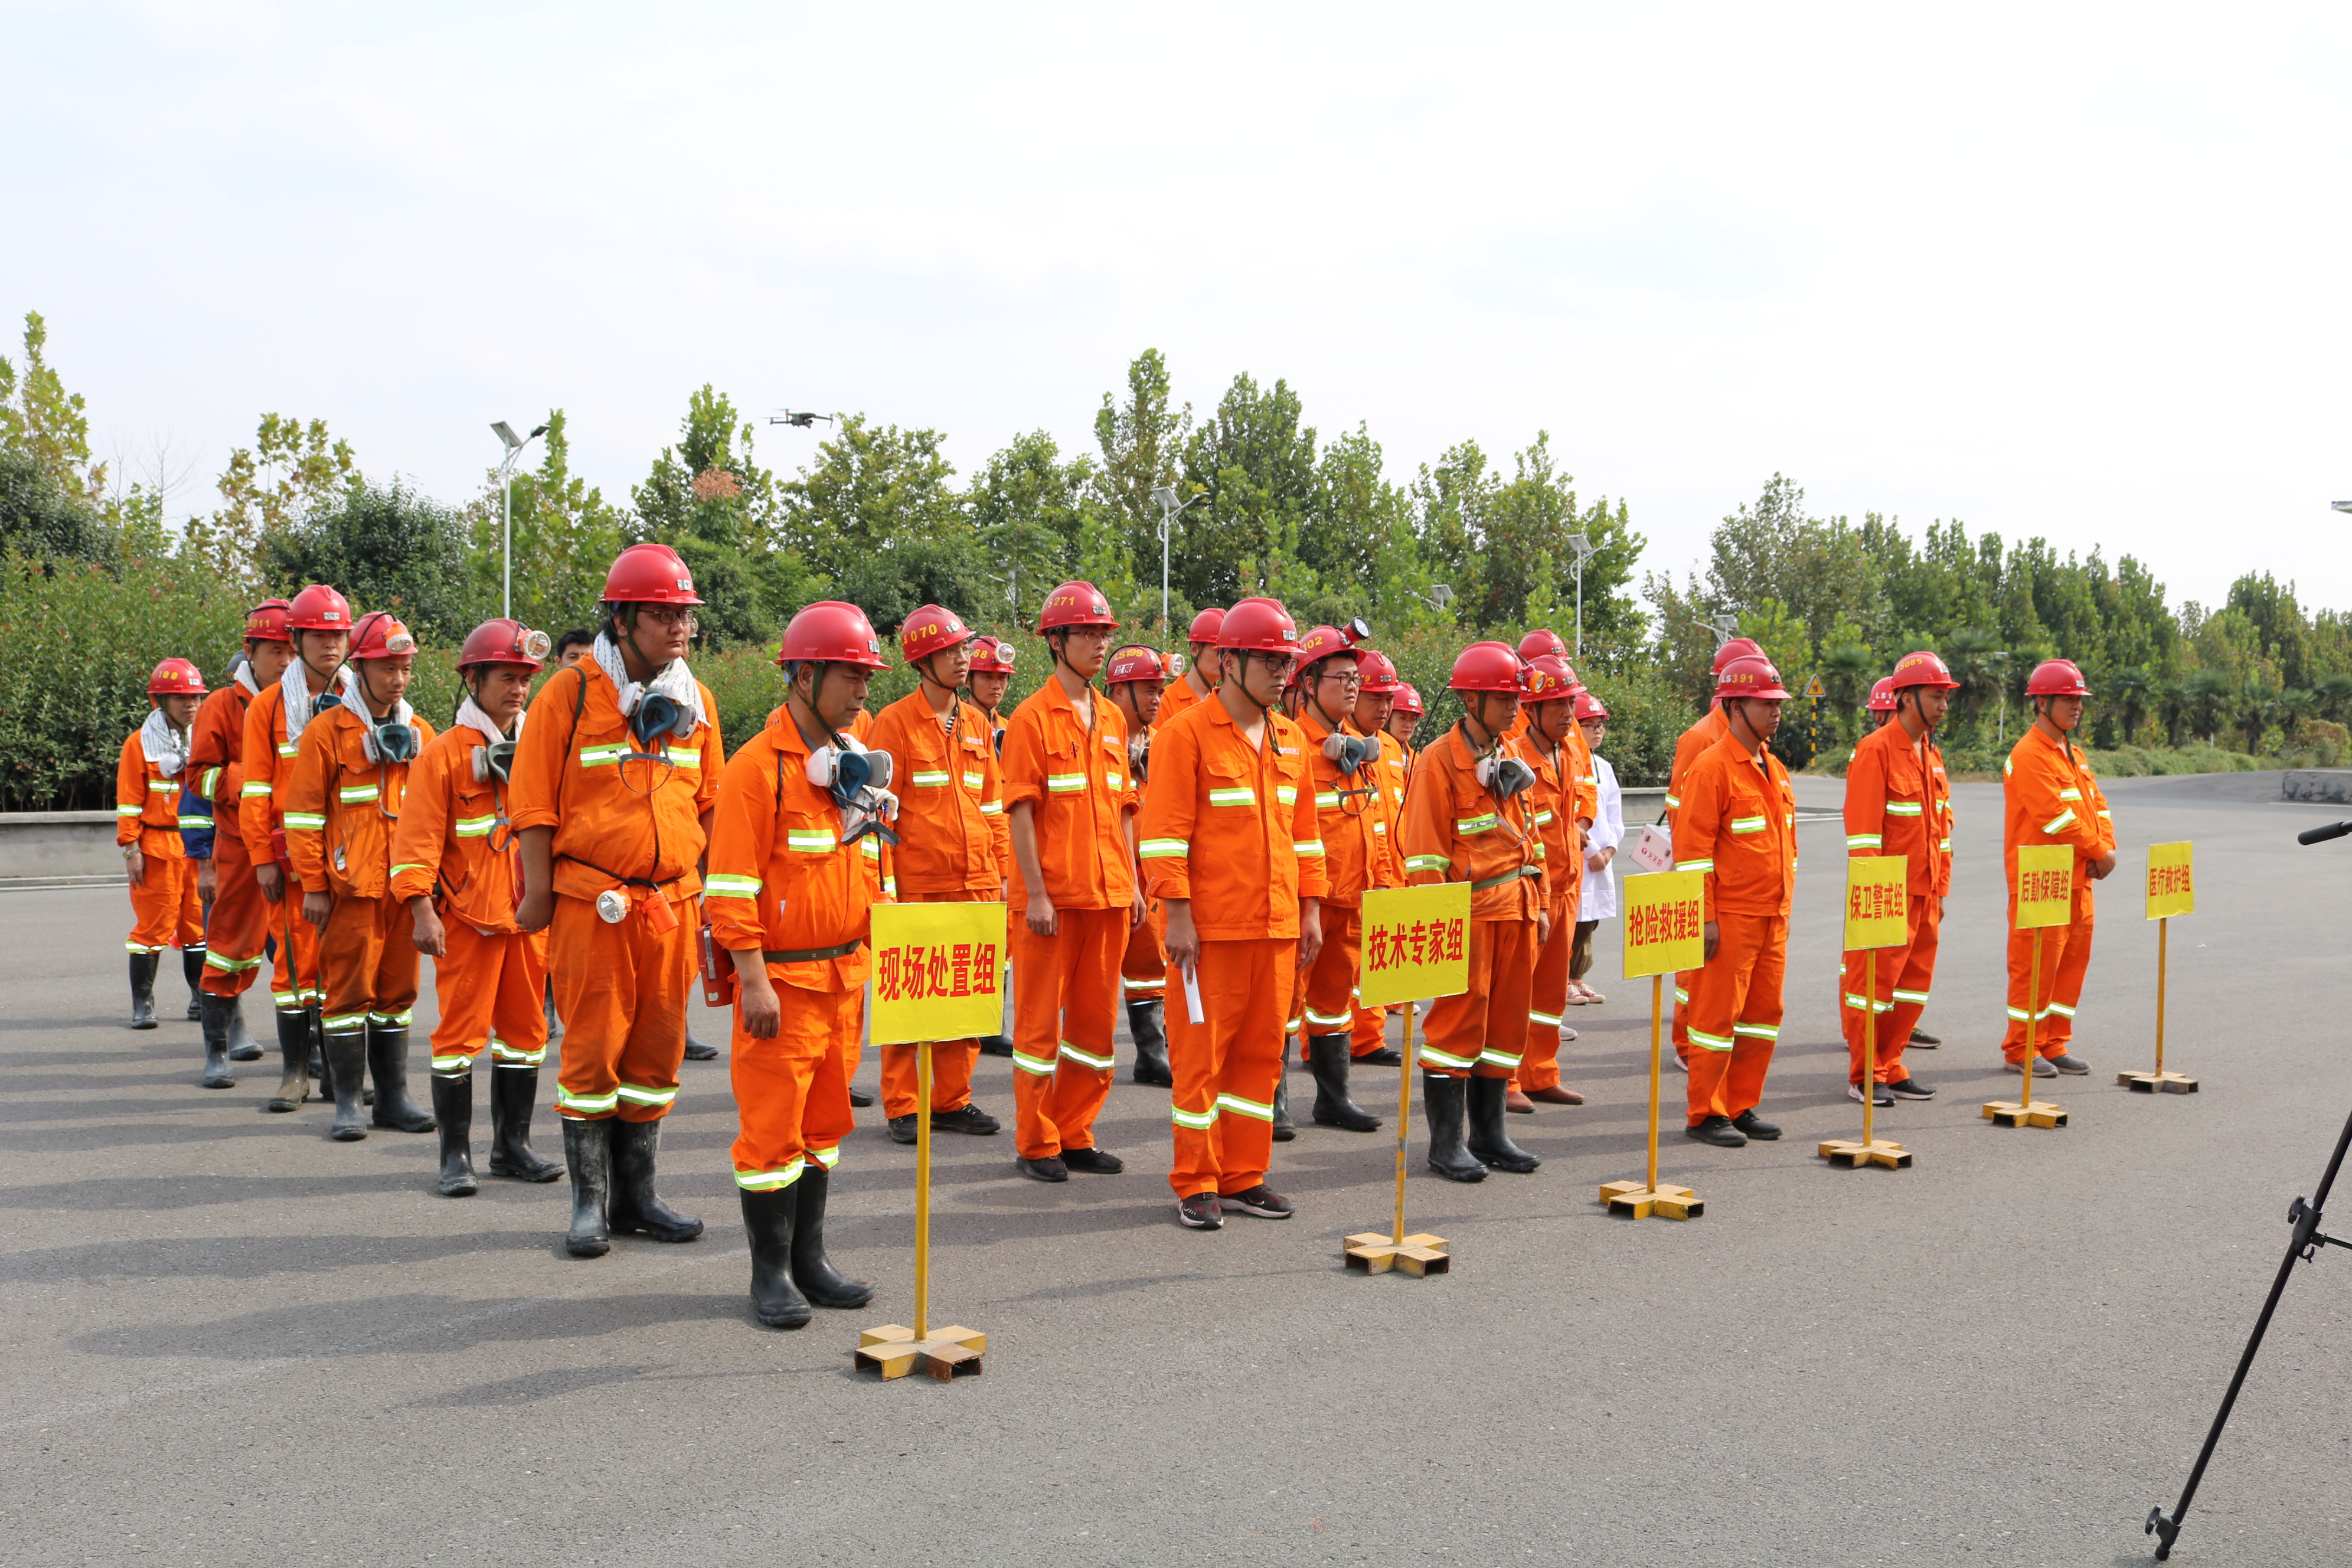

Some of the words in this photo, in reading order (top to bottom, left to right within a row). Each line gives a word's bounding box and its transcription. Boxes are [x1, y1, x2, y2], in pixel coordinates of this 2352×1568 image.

[1113, 649, 1144, 661] LS199
[1302, 636, 1323, 651] 102
[158, 670, 178, 680] 100
[1721, 674, 1754, 684] LS391
[2021, 869, 2069, 904] 后勤保障组
[2150, 864, 2190, 897] 医疗救护组
[1850, 881, 1904, 922] 保卫警戒组
[1629, 899, 1700, 948] 抢险救援组
[1368, 917, 1464, 972] 技术专家组
[878, 942, 996, 1003] 现场处置组
